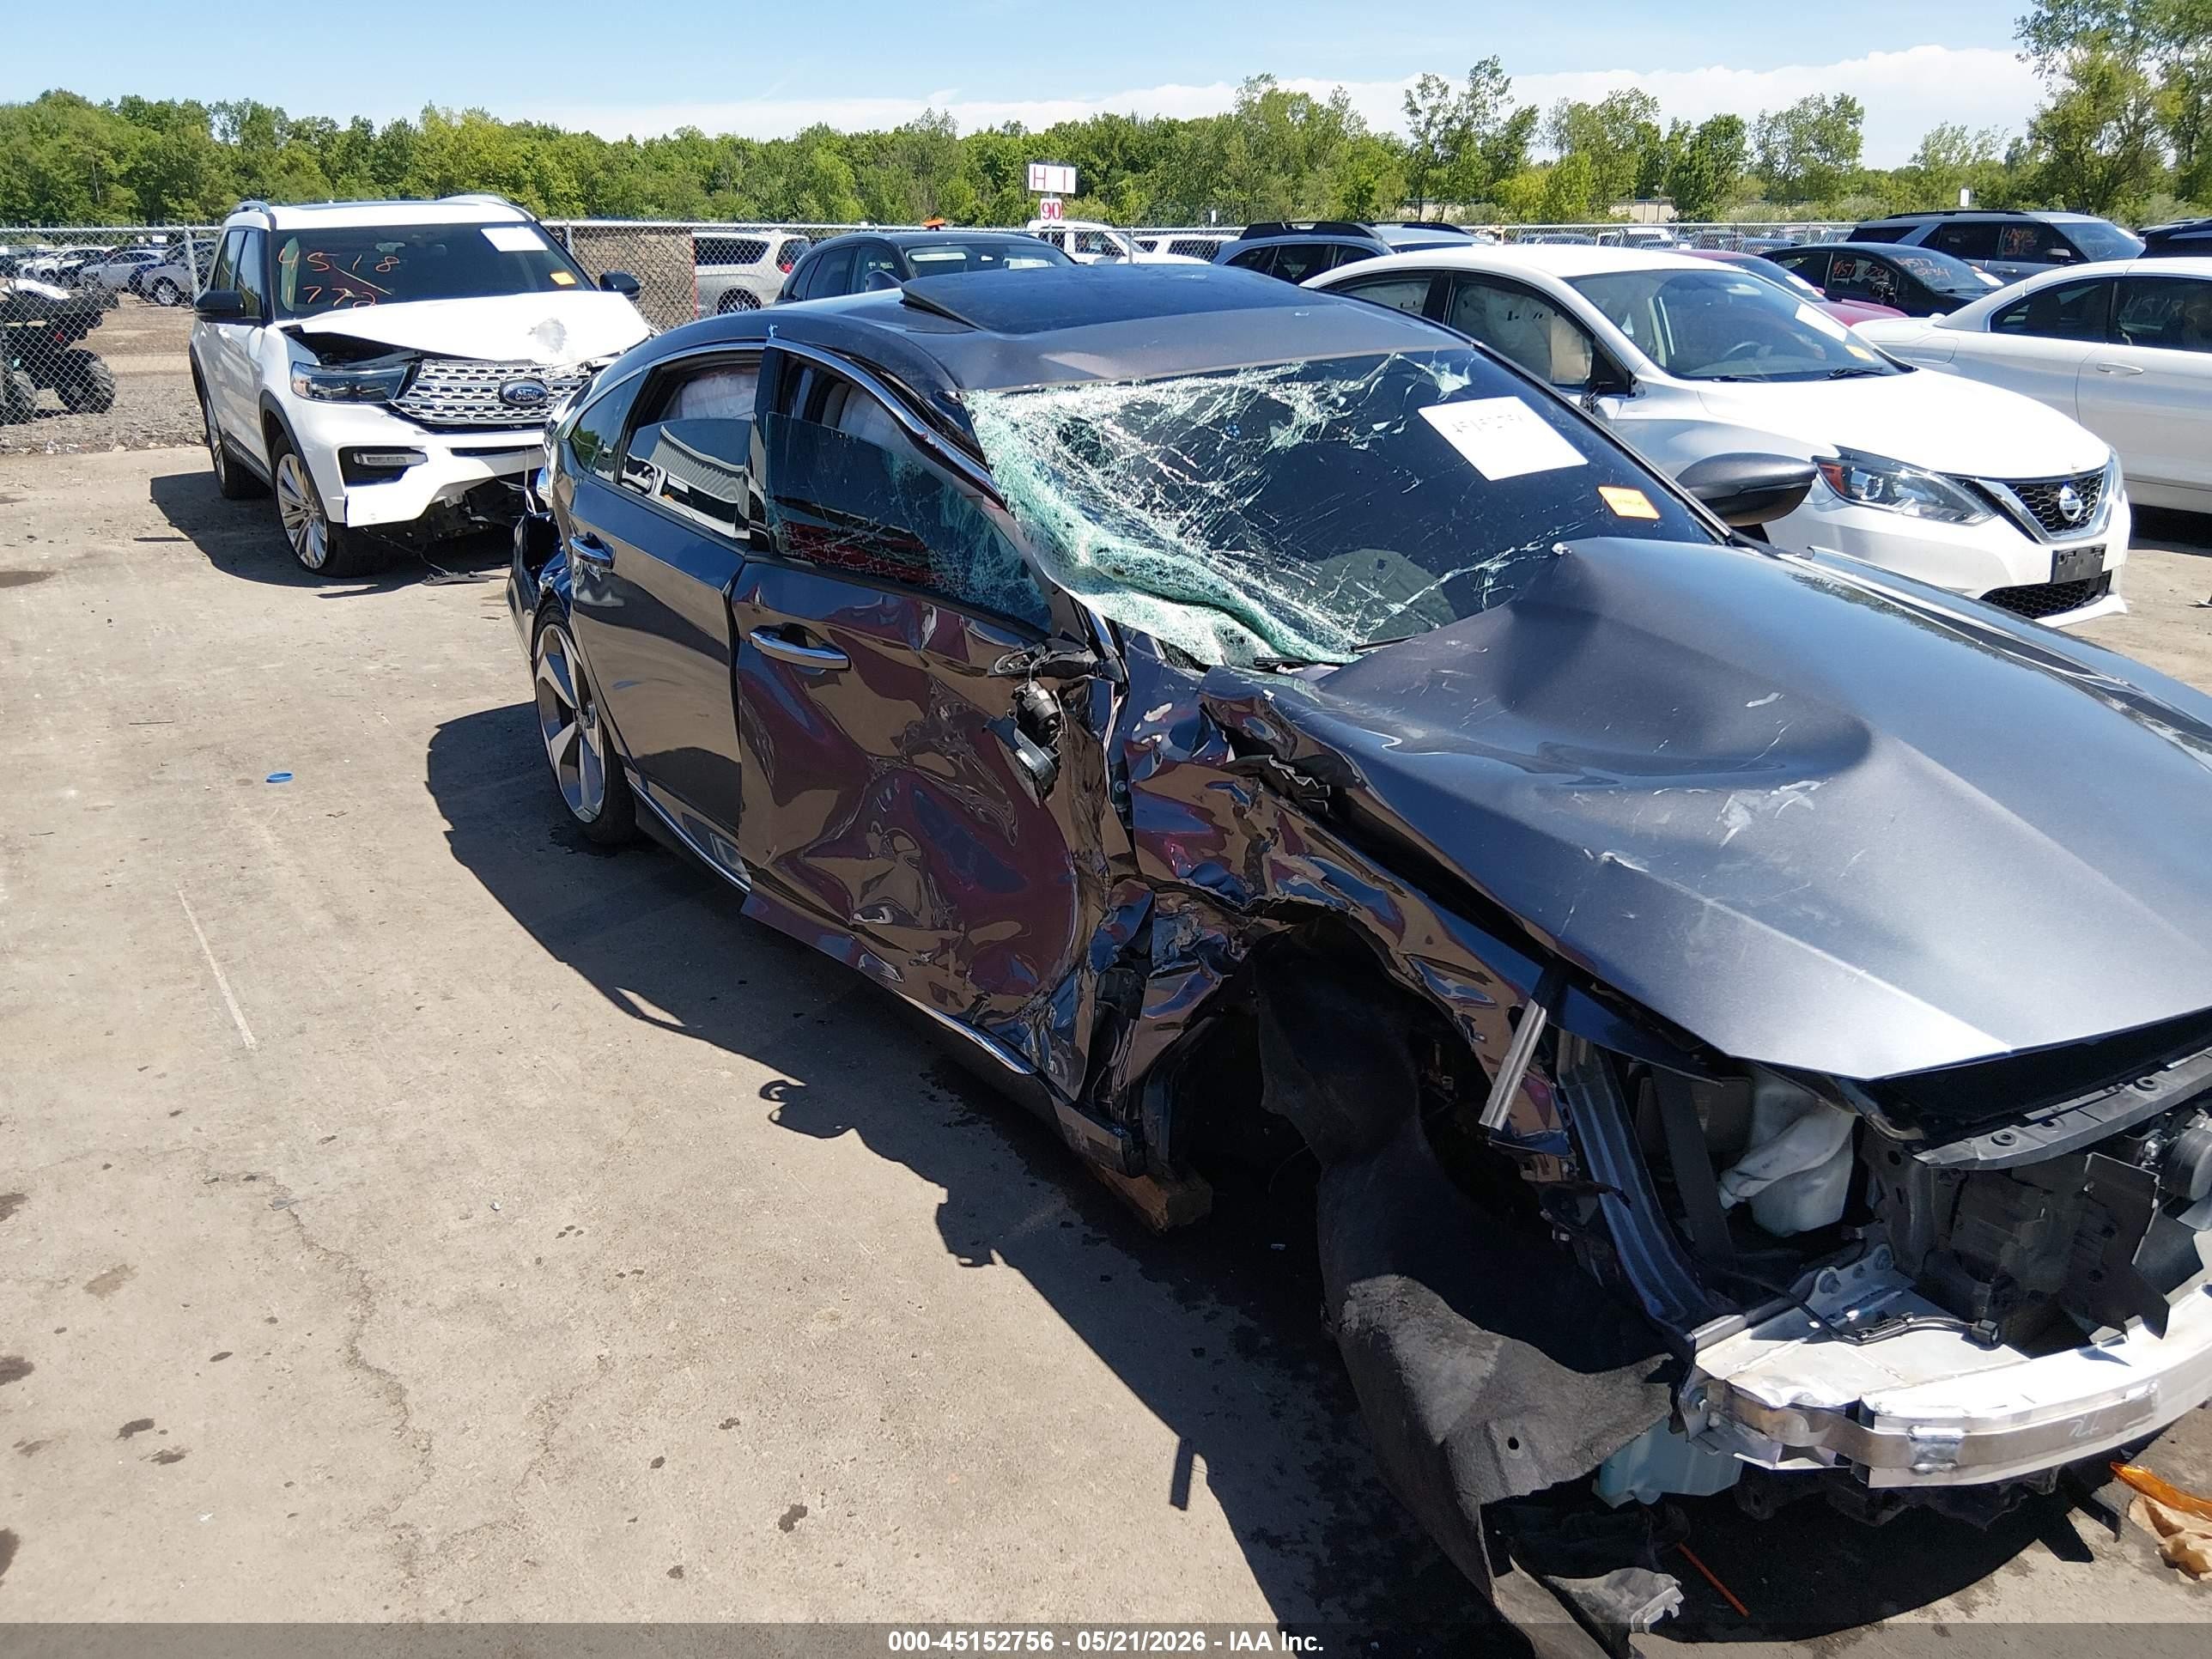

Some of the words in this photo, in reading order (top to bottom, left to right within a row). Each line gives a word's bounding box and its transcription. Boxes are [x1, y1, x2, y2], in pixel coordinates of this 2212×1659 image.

[1034, 167, 1046, 189] H
[1041, 202, 1061, 220] 90
[514, 388, 540, 401] Ford
